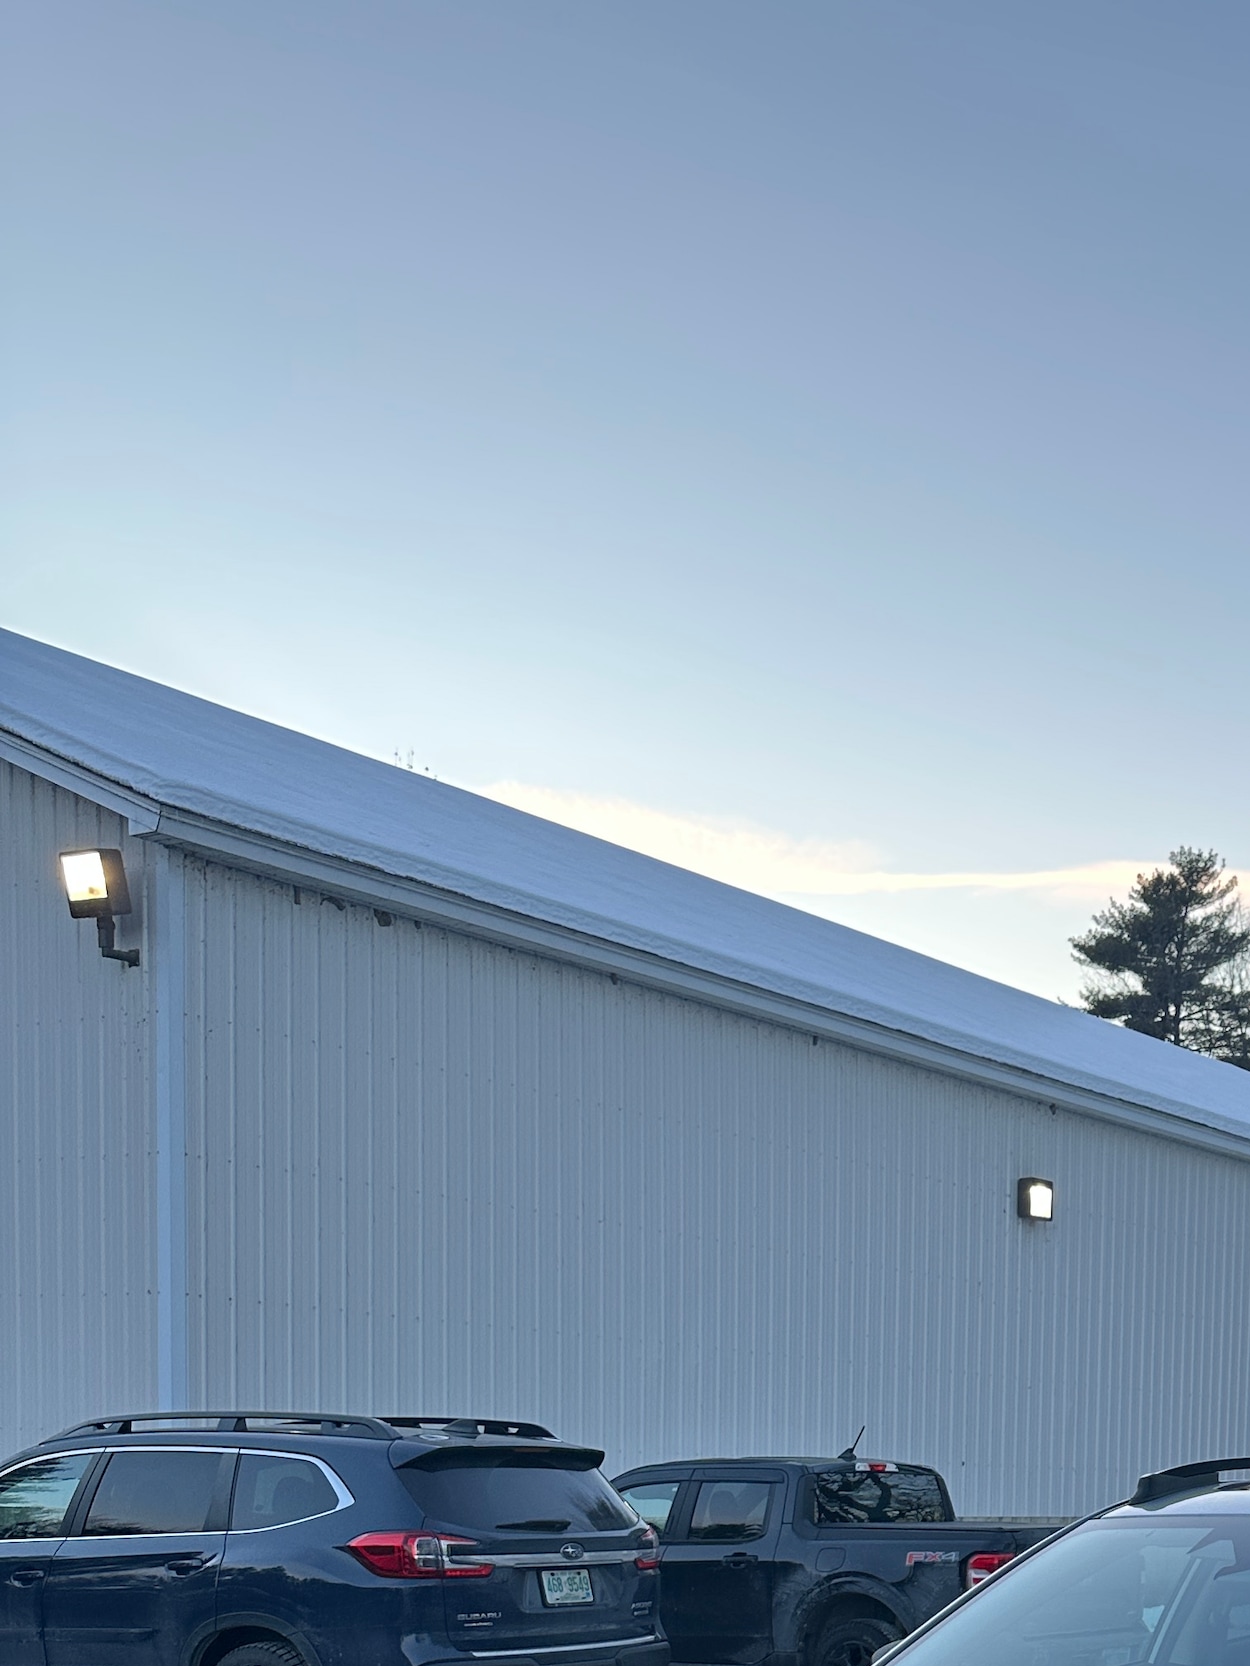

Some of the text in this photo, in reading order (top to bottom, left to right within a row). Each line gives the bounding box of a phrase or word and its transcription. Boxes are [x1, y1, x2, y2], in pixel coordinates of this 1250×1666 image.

[906, 1551, 959, 1566] FX4
[547, 1575, 590, 1592] 468 9549
[457, 1611, 502, 1621] SUBARU
